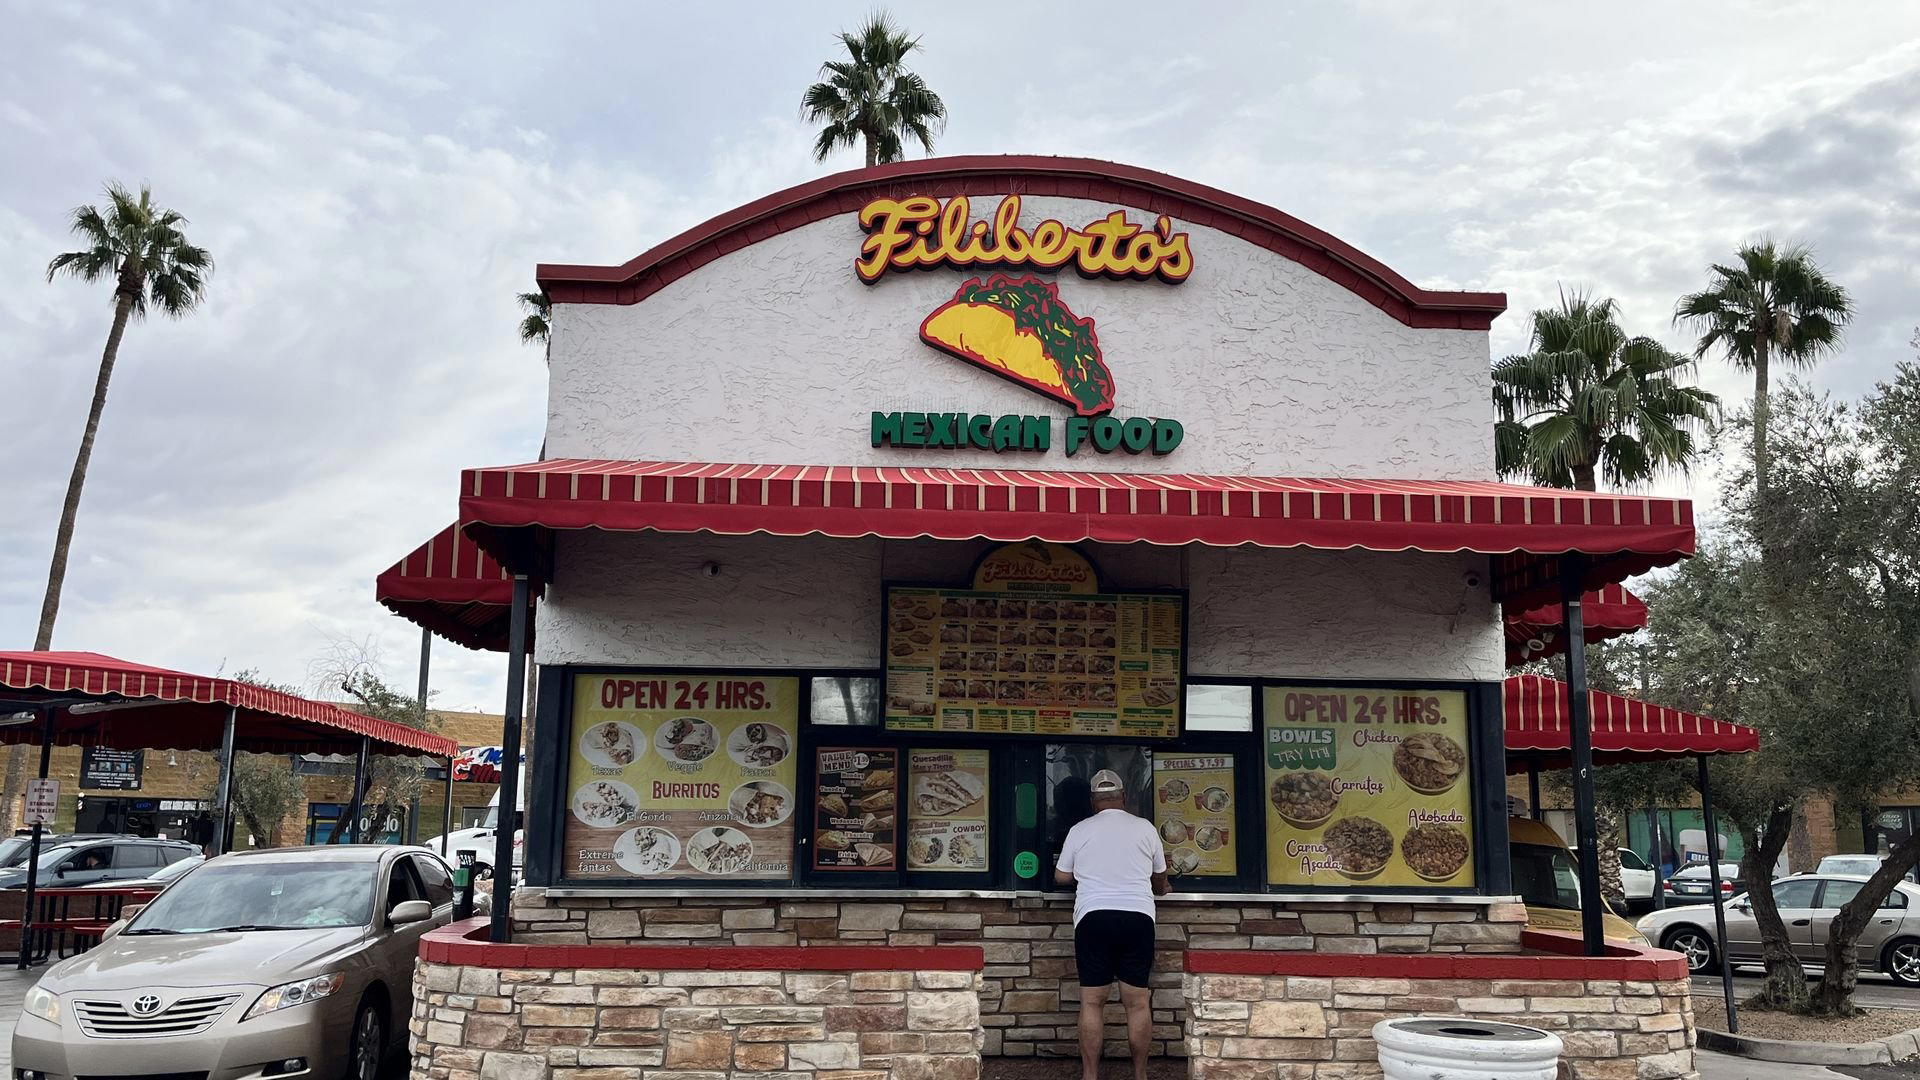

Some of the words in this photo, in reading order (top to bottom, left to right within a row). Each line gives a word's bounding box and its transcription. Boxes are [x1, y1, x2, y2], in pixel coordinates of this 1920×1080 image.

[855, 194, 1193, 285] Filiberto's
[871, 411, 1050, 453] MEXICAN
[1065, 416, 1184, 457] FOOD
[602, 679, 667, 709] OPEN
[674, 681, 709, 709] 24
[715, 681, 771, 710] HRS.
[1284, 693, 1347, 722] OPEN
[1353, 696, 1387, 724] 24
[1393, 697, 1447, 725] HRS.
[1269, 729, 1333, 744] BOWLS
[1352, 729, 1404, 748] Chicken
[821, 751, 851, 763] VALUE
[824, 761, 851, 771] MENU
[912, 754, 954, 763] Quesadilla
[1163, 758, 1196, 769] SPECIALS
[666, 761, 703, 774] Veggie
[652, 781, 720, 799] BURRITOS
[1330, 776, 1385, 796] Carnitas
[640, 812, 672, 822] Gordo
[1408, 808, 1466, 829] Adobada
[952, 824, 985, 834] COWBOY
[1286, 840, 1327, 858] Carne
[1301, 857, 1343, 876] Asada
